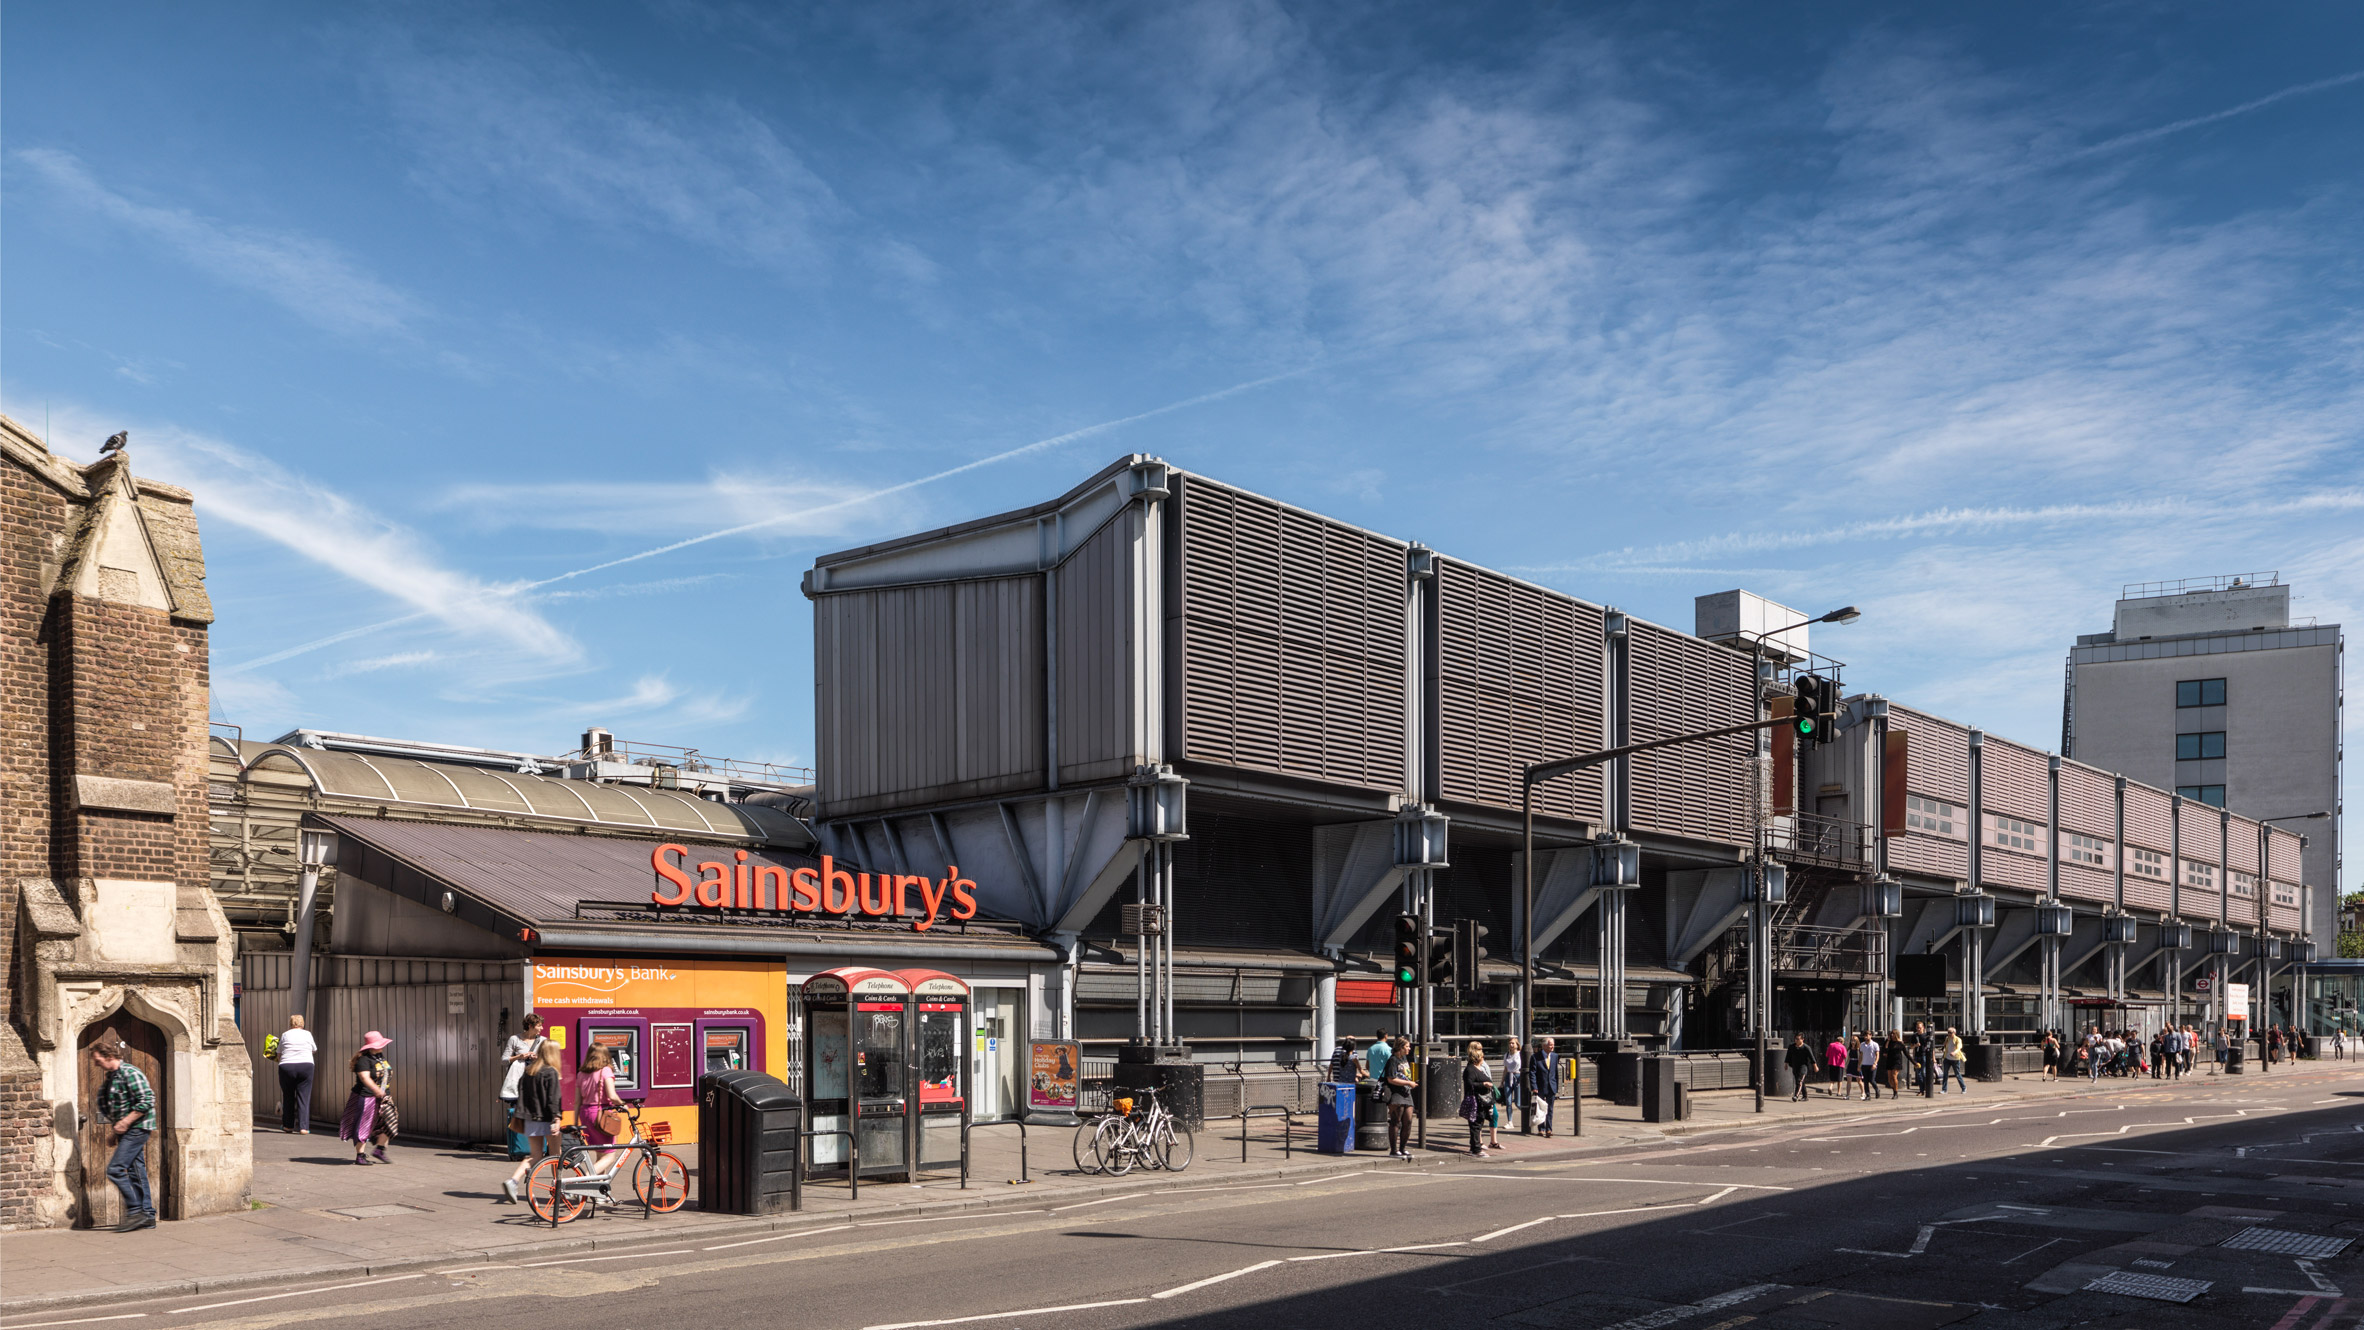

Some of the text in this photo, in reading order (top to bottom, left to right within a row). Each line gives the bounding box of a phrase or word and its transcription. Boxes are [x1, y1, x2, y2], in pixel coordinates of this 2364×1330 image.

[651, 843, 977, 932] Sainsbury's
[536, 963, 669, 983] Sainsbury's Bank
[815, 982, 835, 990] Telephone
[867, 981, 894, 990] Telephone
[928, 982, 954, 991] Telephone
[554, 996, 570, 1004] cash
[571, 997, 614, 1005] withdrawals
[864, 994, 877, 1002] Coins
[944, 995, 956, 1003] Cards
[588, 1008, 639, 1016] sainsburysbank.co.uk
[704, 1008, 750, 1016] sainsburysbank.co.uk
